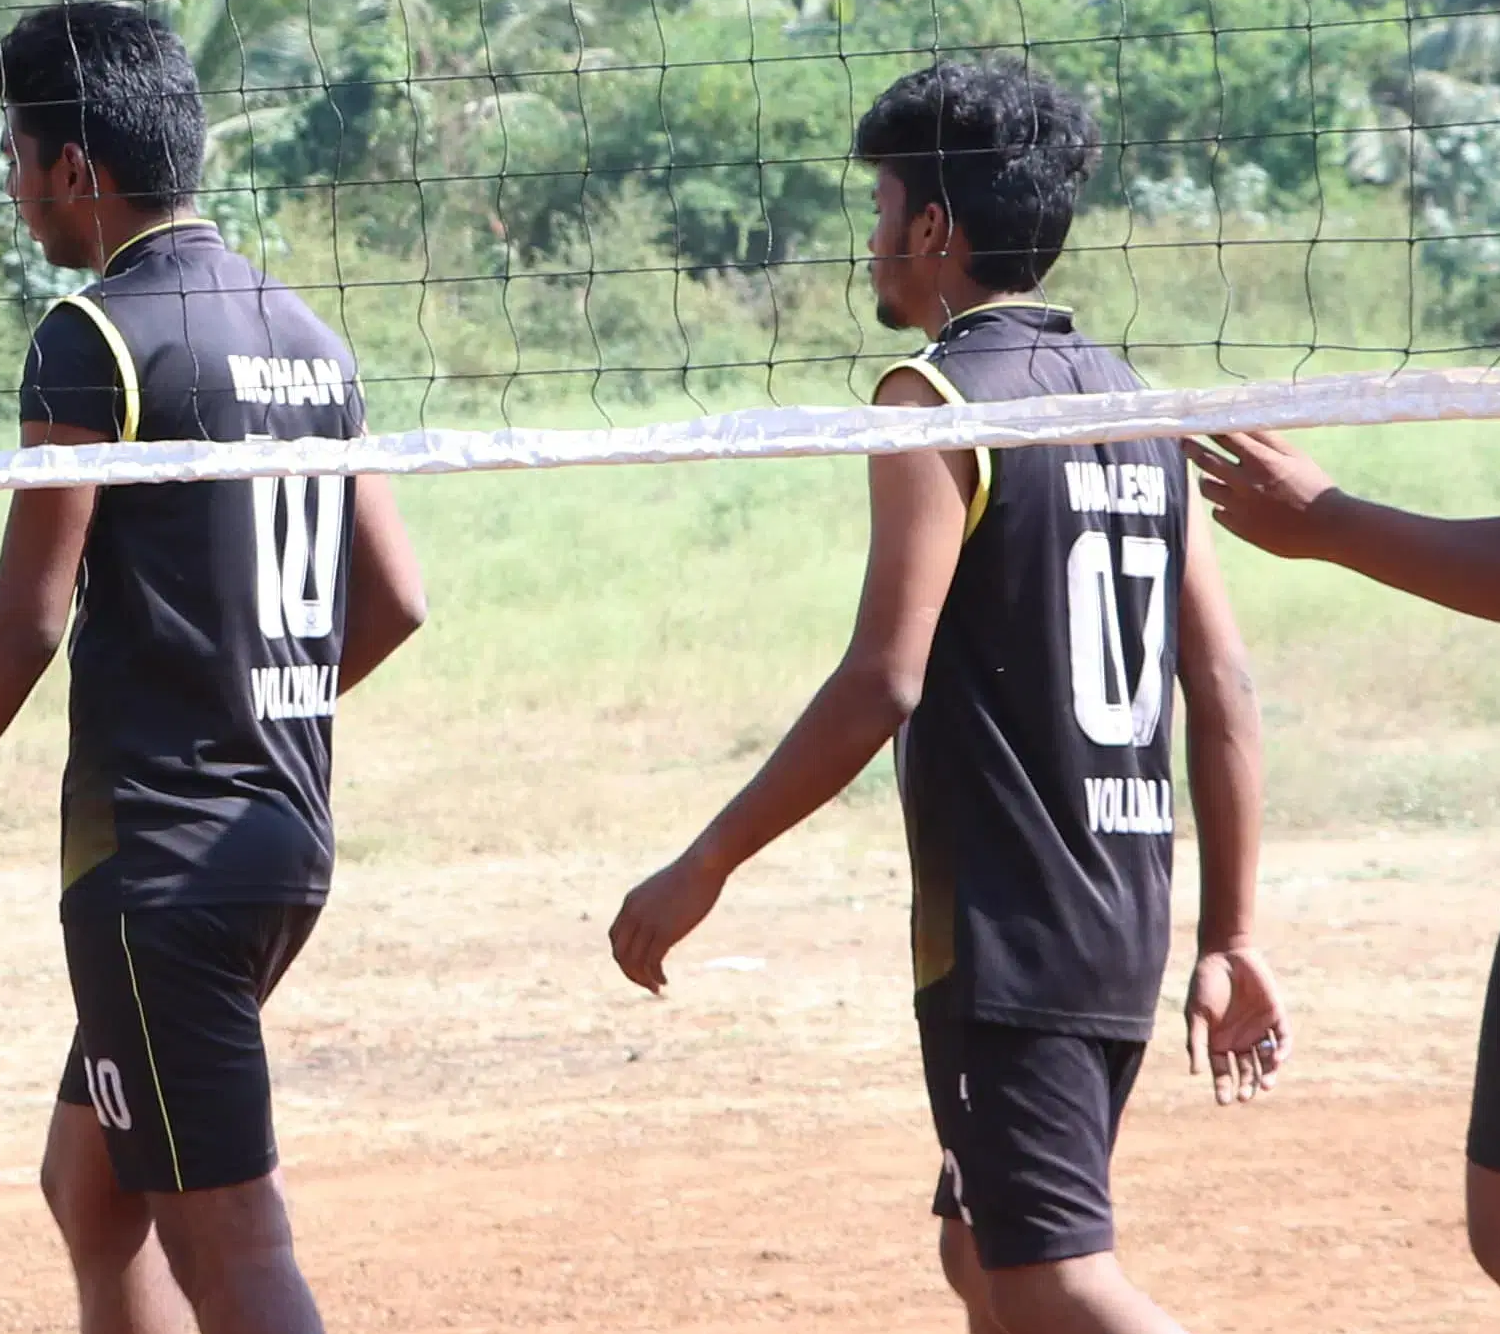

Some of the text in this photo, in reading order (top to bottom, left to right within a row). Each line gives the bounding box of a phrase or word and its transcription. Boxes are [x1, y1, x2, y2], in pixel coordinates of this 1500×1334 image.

[227, 354, 345, 406] MOHAN
[245, 432, 345, 639] 10
[1067, 530, 1168, 747] 07
[84, 1057, 132, 1130] 10
